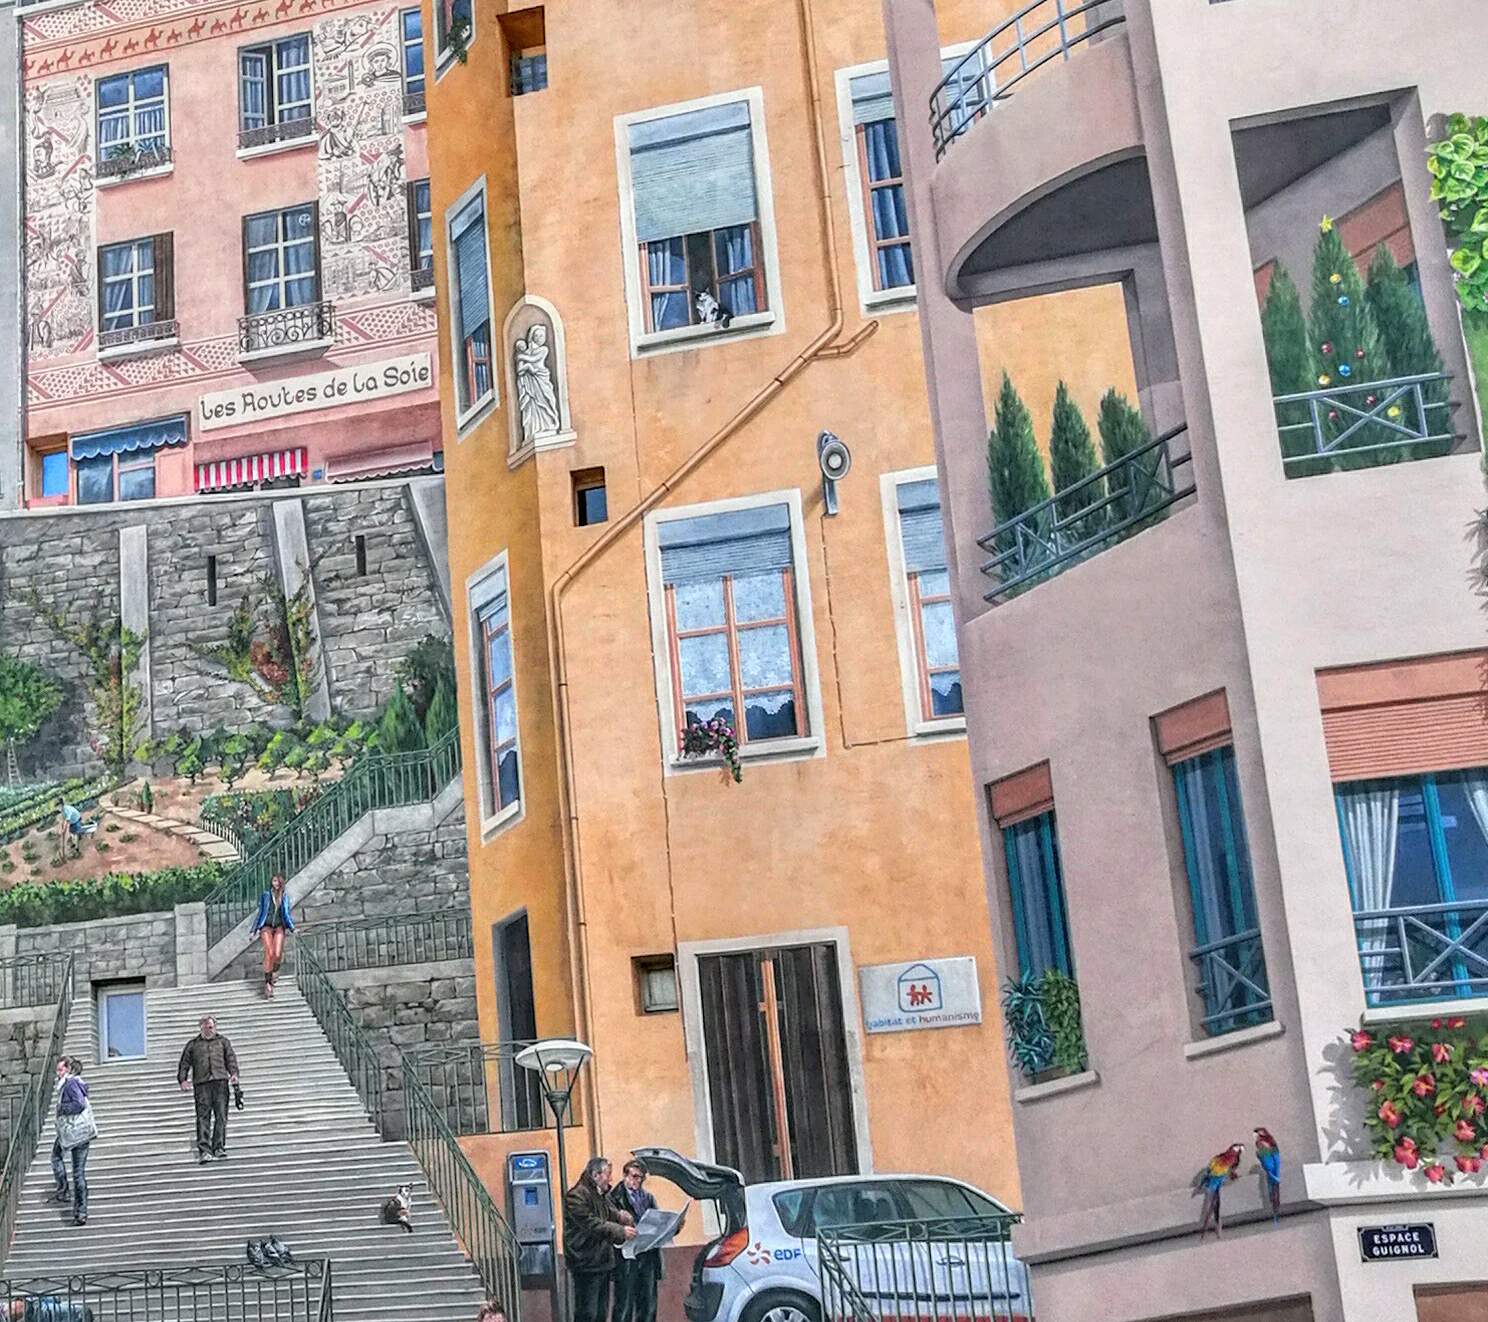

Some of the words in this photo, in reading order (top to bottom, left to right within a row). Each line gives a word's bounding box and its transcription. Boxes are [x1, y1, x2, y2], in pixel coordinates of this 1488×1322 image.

[201, 399, 236, 420] Les
[323, 379, 348, 399] de
[383, 361, 429, 387] Soie
[1373, 1231, 1420, 1244] ESPACE
[1372, 1244, 1425, 1256] GUIGNOL
